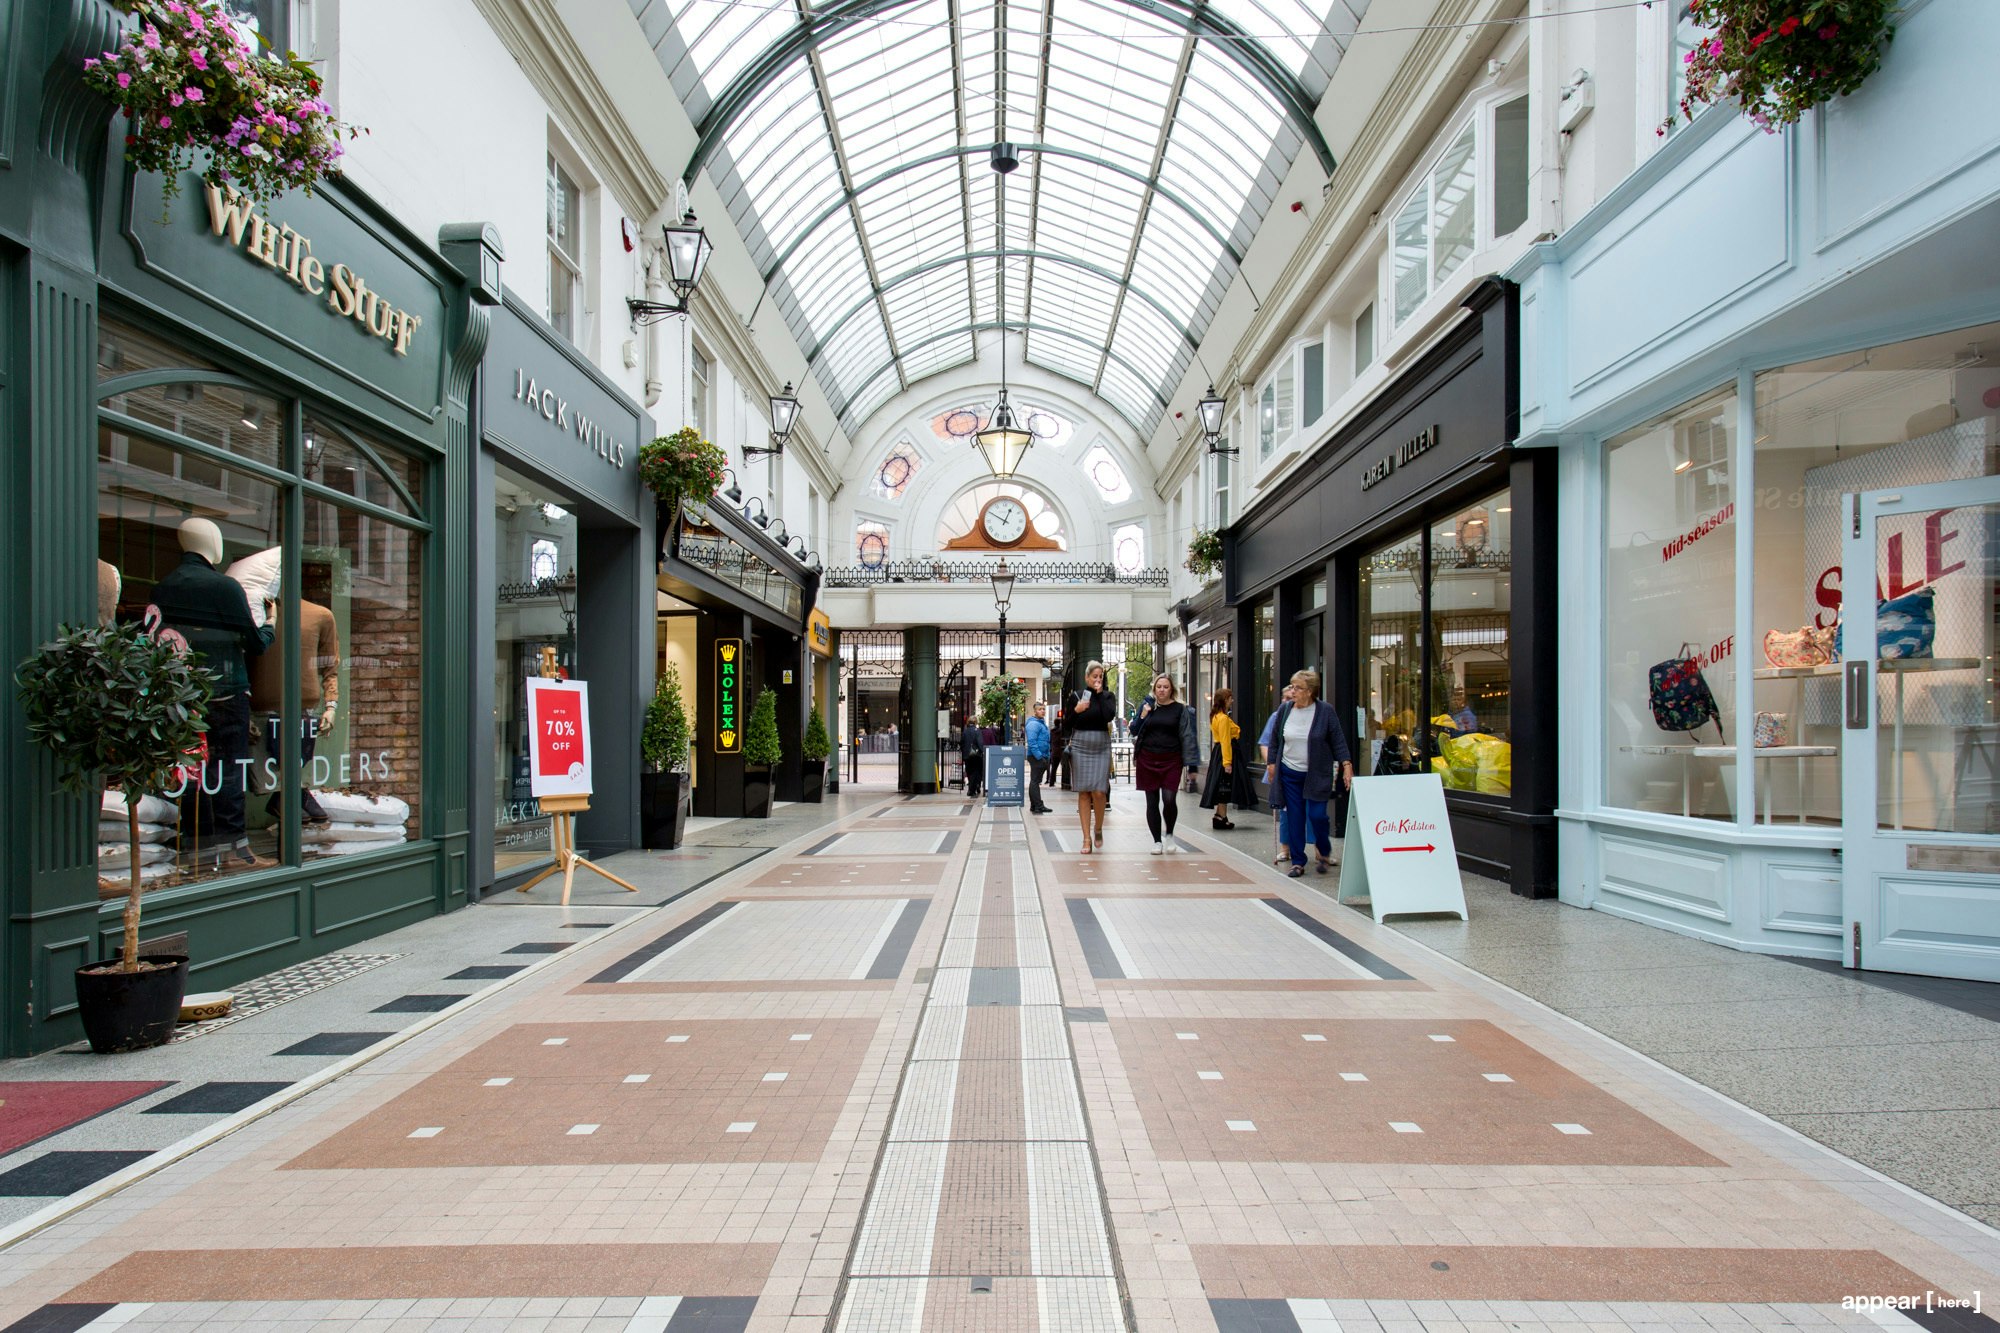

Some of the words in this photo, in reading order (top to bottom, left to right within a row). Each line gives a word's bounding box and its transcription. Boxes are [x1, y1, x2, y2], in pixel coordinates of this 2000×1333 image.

[516, 367, 568, 430] JACK
[575, 410, 624, 469] WILLS
[1360, 455, 1392, 491] KAREN
[1395, 424, 1437, 469] MILLEN
[1662, 502, 1735, 564] Mid-season
[1815, 508, 1966, 630] SLE
[1710, 635, 1735, 664] OFF
[722, 663, 735, 729] ROLEX
[546, 720, 575, 736] 70%
[552, 742, 571, 751] OFF
[570, 766, 584, 780] SALE
[997, 767, 1017, 775] OPEN
[494, 801, 527, 827] JACK
[1375, 819, 1397, 835] Cath
[1398, 818, 1435, 834] Kidston
[506, 830, 532, 847] POP-UP
